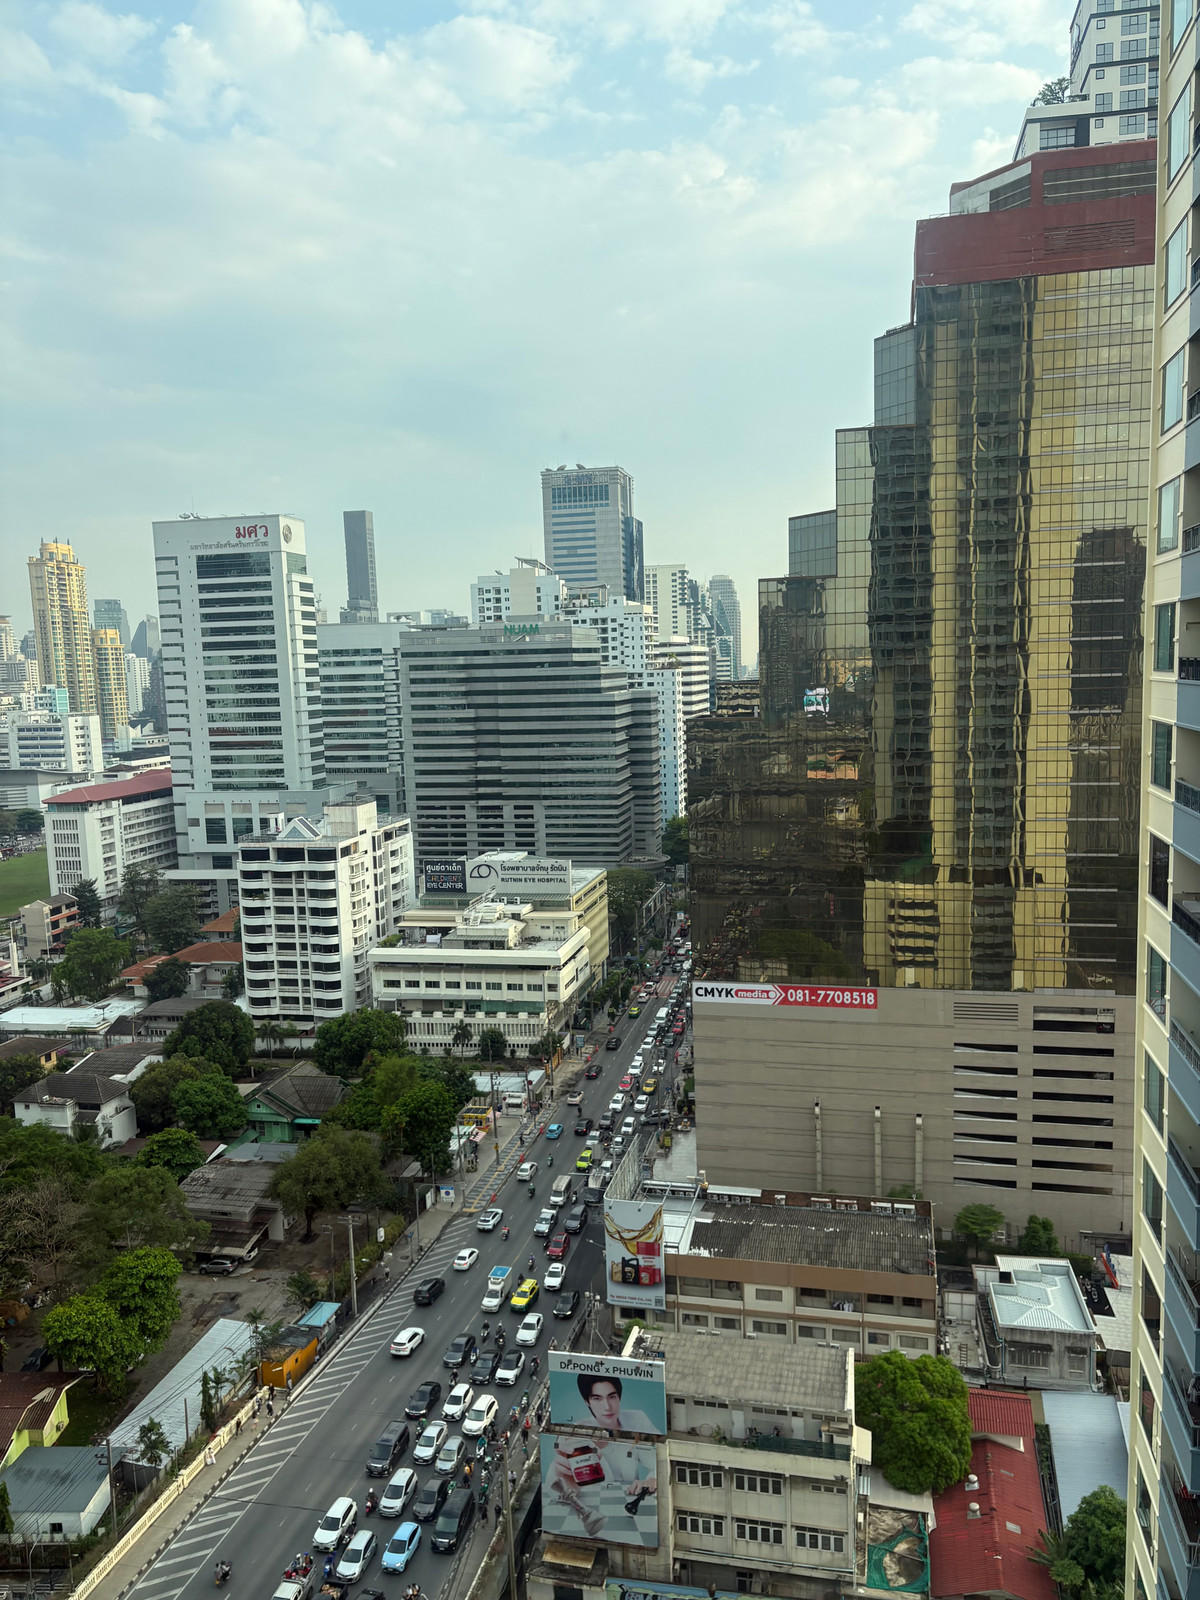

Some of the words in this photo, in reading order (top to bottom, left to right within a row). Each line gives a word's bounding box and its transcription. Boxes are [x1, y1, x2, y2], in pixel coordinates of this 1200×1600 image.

[236, 524, 268, 538] มศว
[426, 863, 461, 872] ศูนย์ตาเด็ก
[500, 864, 548, 874] โรงพยาบาลจักษุ
[695, 986, 734, 998] CMYK
[787, 989, 874, 1004] 081-7708518
[613, 1367, 653, 1378] PHUWIN
